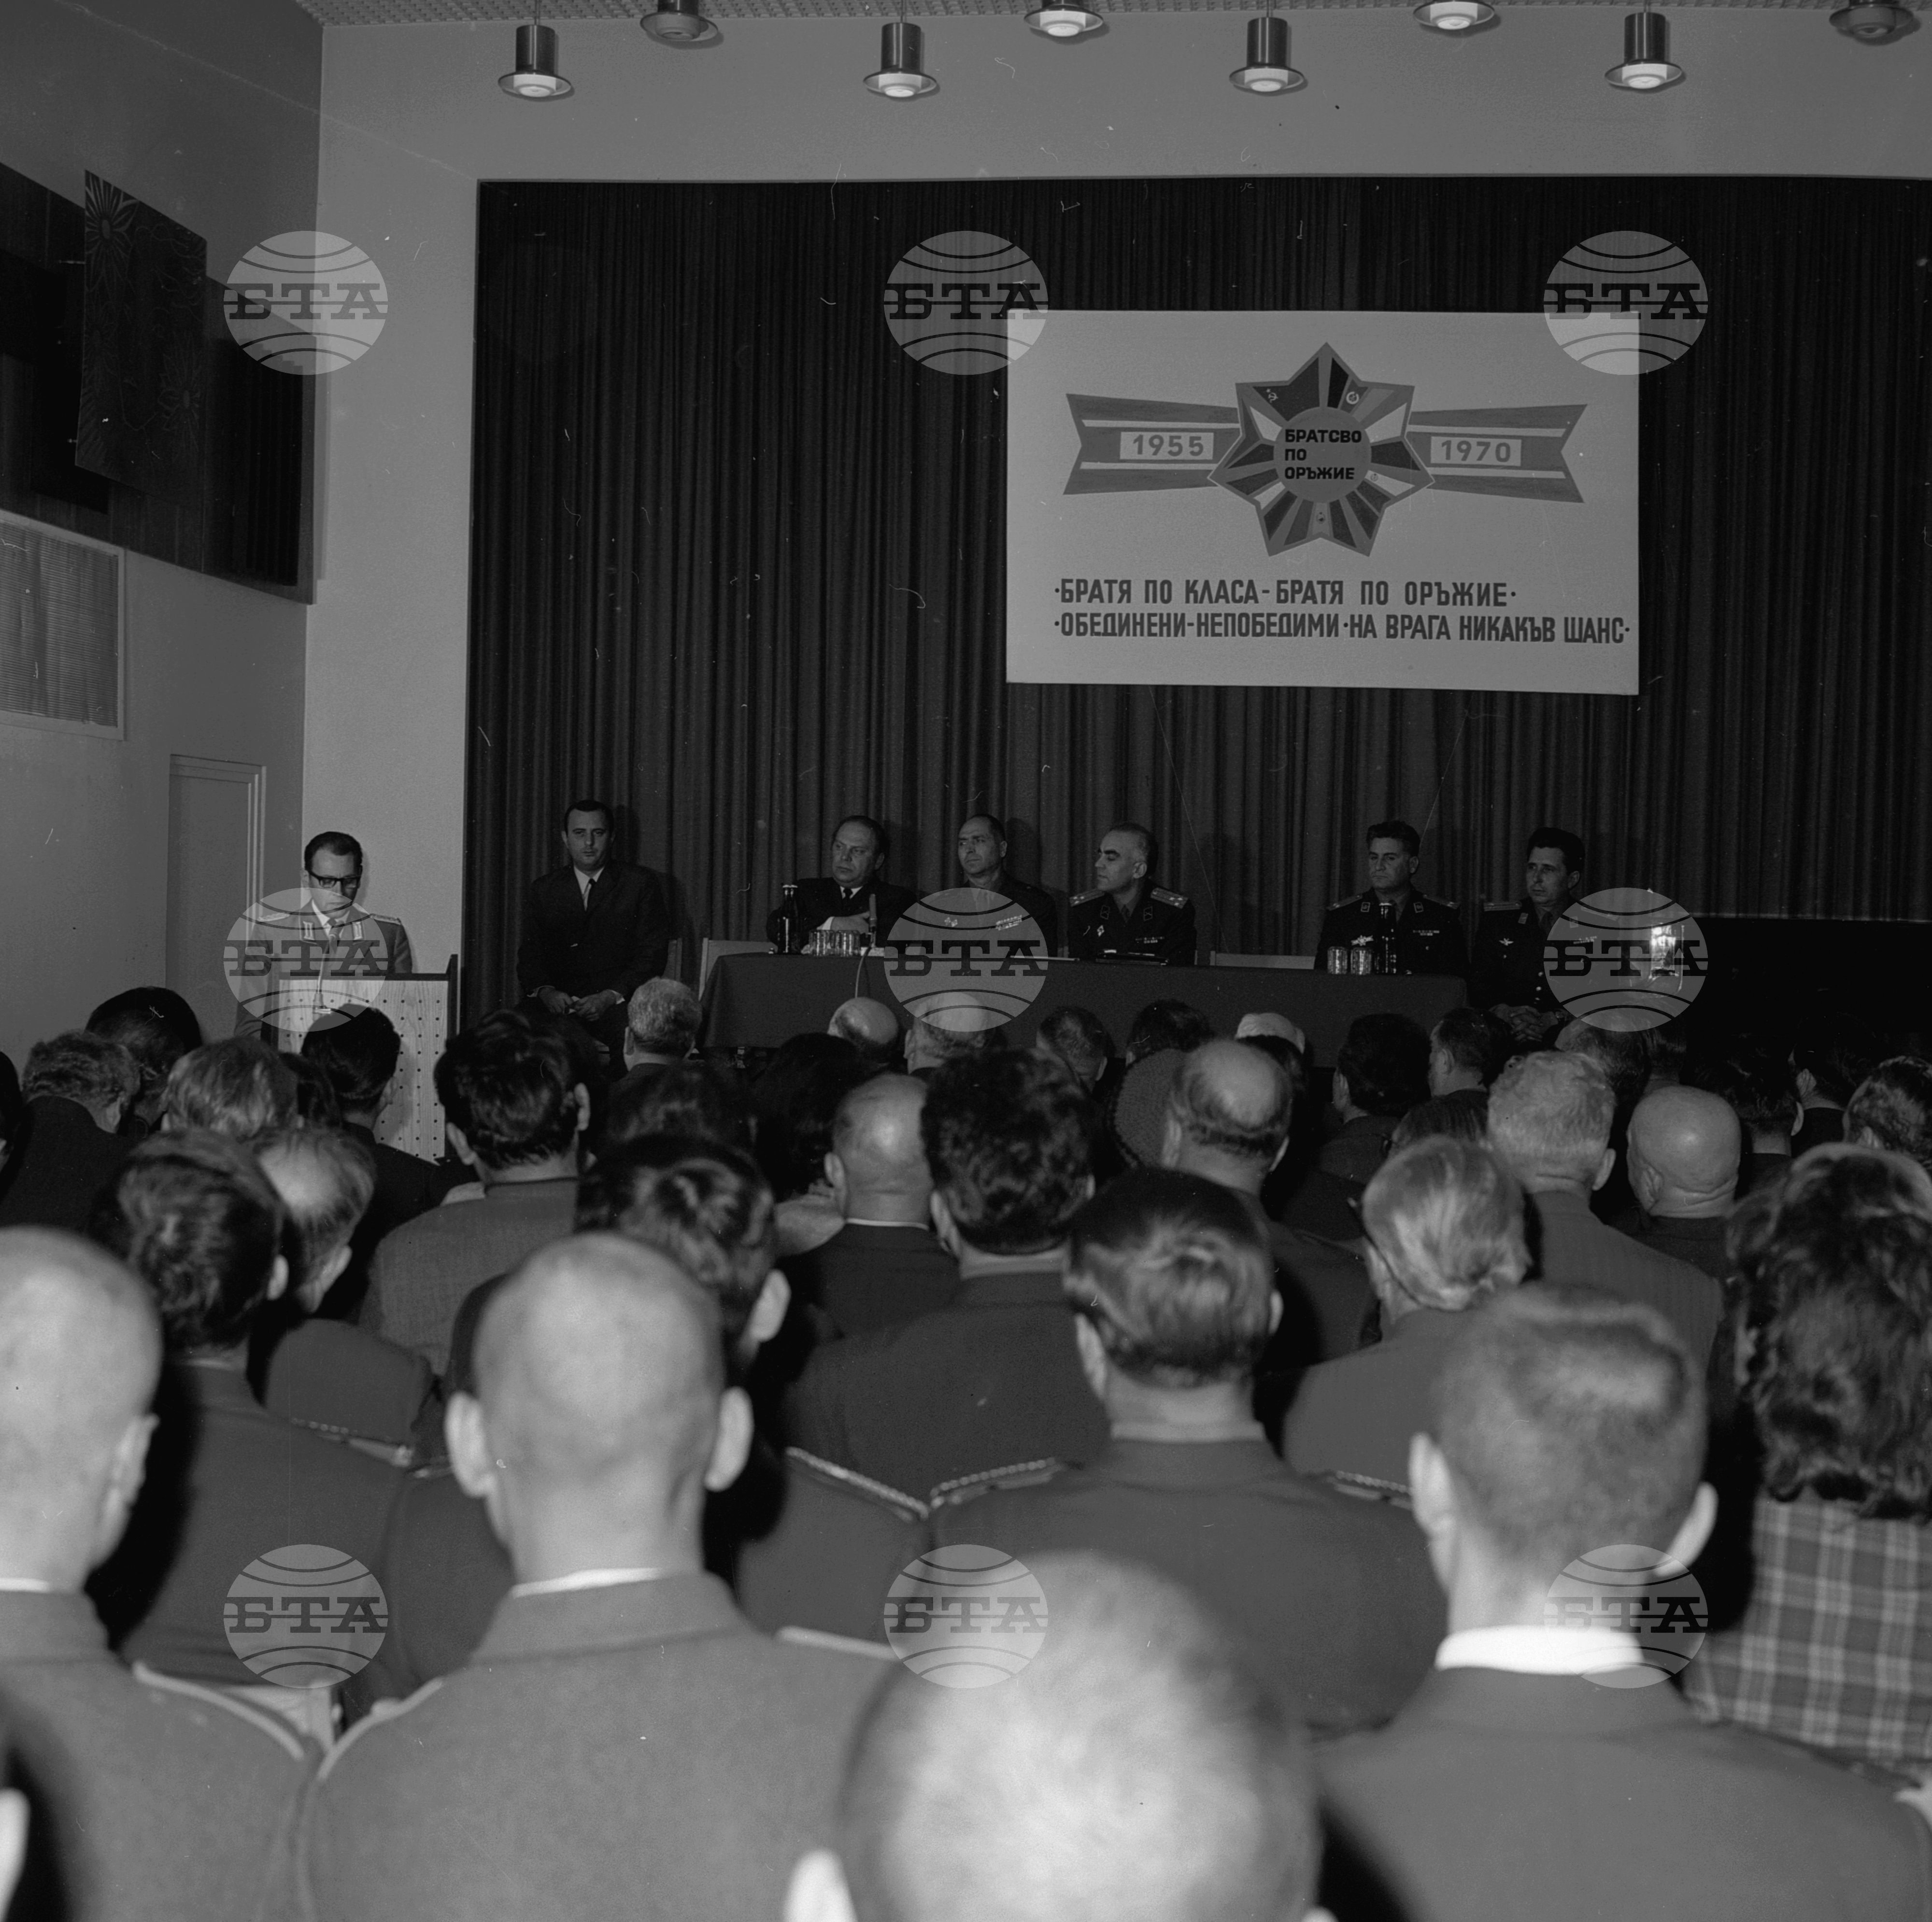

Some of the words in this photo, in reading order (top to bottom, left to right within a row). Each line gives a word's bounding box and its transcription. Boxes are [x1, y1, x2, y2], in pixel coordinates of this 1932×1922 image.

[1133, 434, 1204, 457] 1955
[1285, 429, 1362, 443] БРАТСВО
[1285, 449, 1307, 461] ПО
[1441, 440, 1511, 463] 1970
[1285, 466, 1355, 480] ОРЪЖИЕ
[1145, 580, 1172, 604] ПО
[1277, 580, 1343, 605] БРАТЯ
[1361, 581, 1389, 606] ПО
[1386, 614, 1451, 640] ВРАГА
[1459, 616, 1555, 642] НИКАКЪВ
